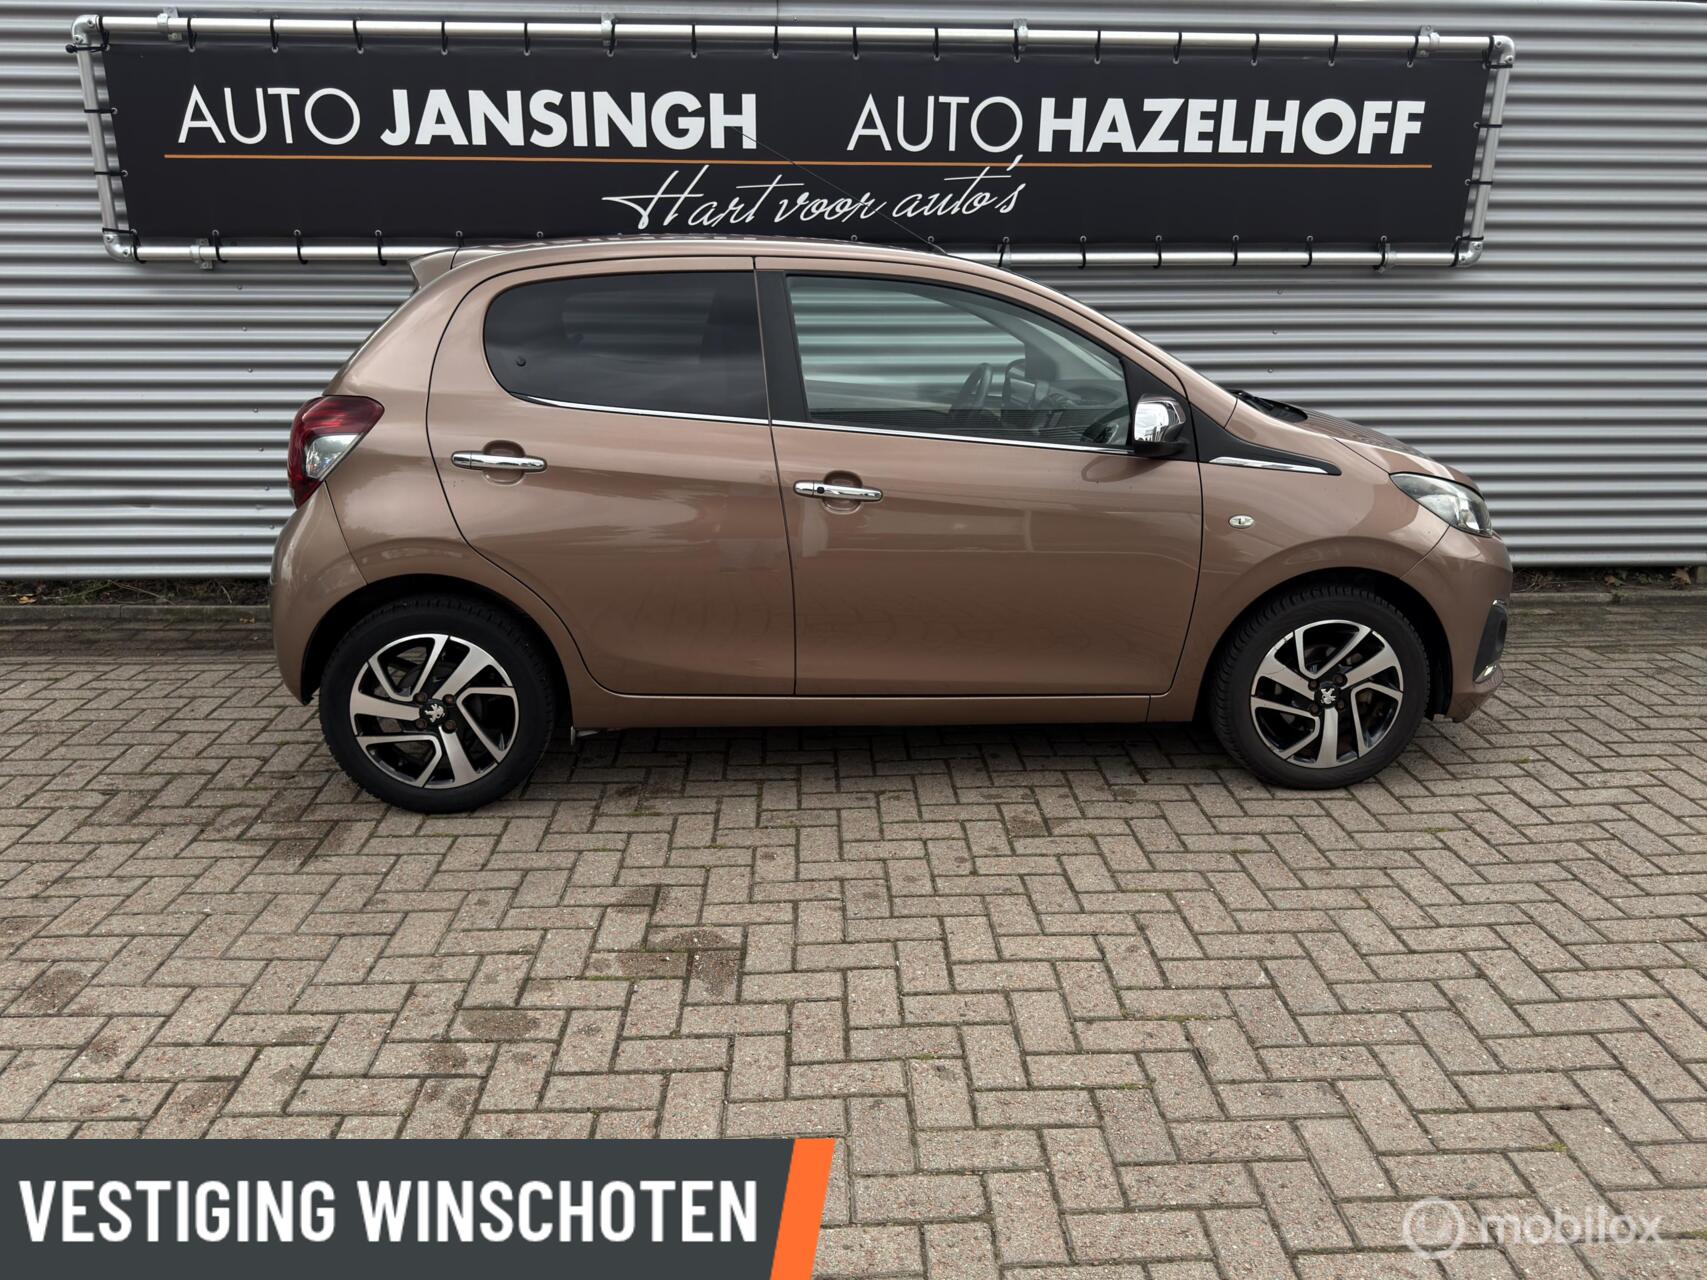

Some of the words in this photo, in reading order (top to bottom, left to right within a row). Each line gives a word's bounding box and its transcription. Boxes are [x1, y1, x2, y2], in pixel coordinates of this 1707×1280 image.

[177, 85, 361, 146] AUTO
[380, 89, 757, 150] JANSINGH
[846, 93, 1023, 153] AUTO
[1038, 97, 1426, 155] HAZELHOFF
[602, 164, 804, 229] Hart
[773, 191, 887, 223] voor
[892, 154, 1027, 218] auto's
